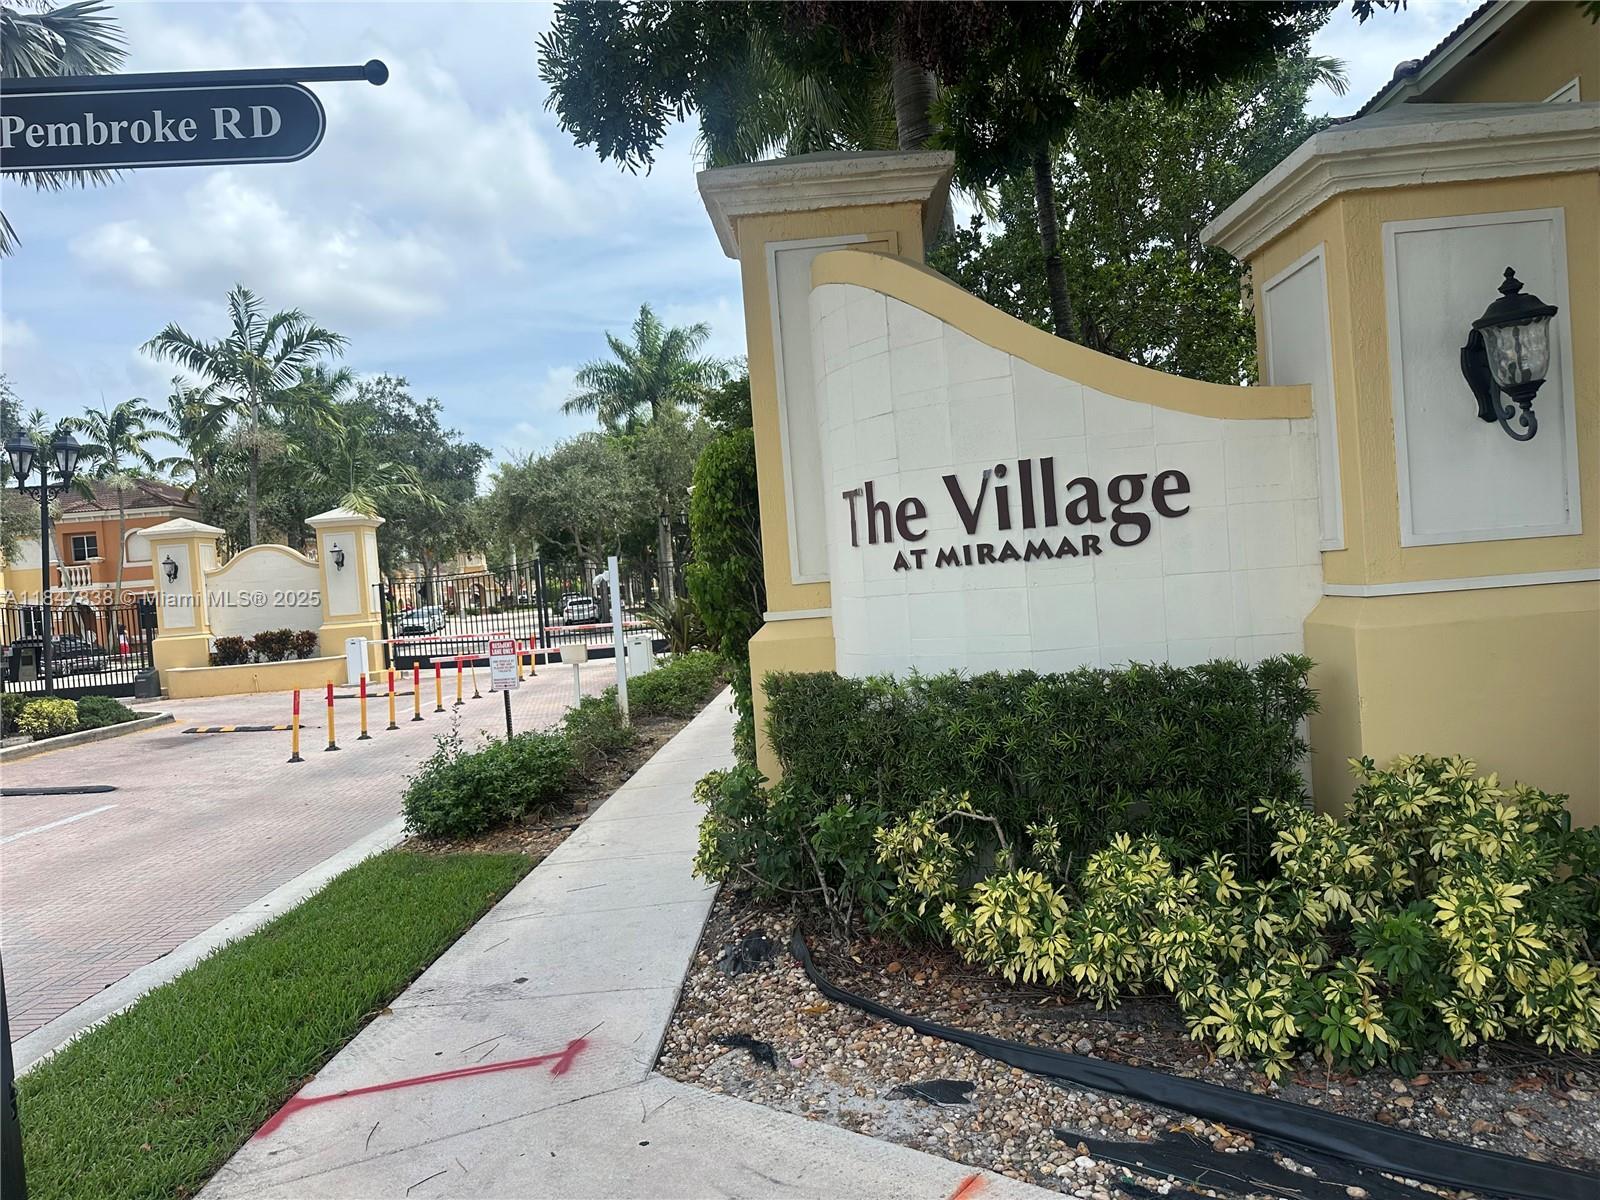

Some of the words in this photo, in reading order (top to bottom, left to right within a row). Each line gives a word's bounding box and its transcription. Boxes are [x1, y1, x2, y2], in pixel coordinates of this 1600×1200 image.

[0, 109, 198, 149] Pembroke
[210, 105, 282, 141] RD
[842, 480, 928, 548] The
[942, 456, 1191, 547] Village
[893, 549, 927, 572] AT
[935, 534, 1103, 569] MIRAMAR
